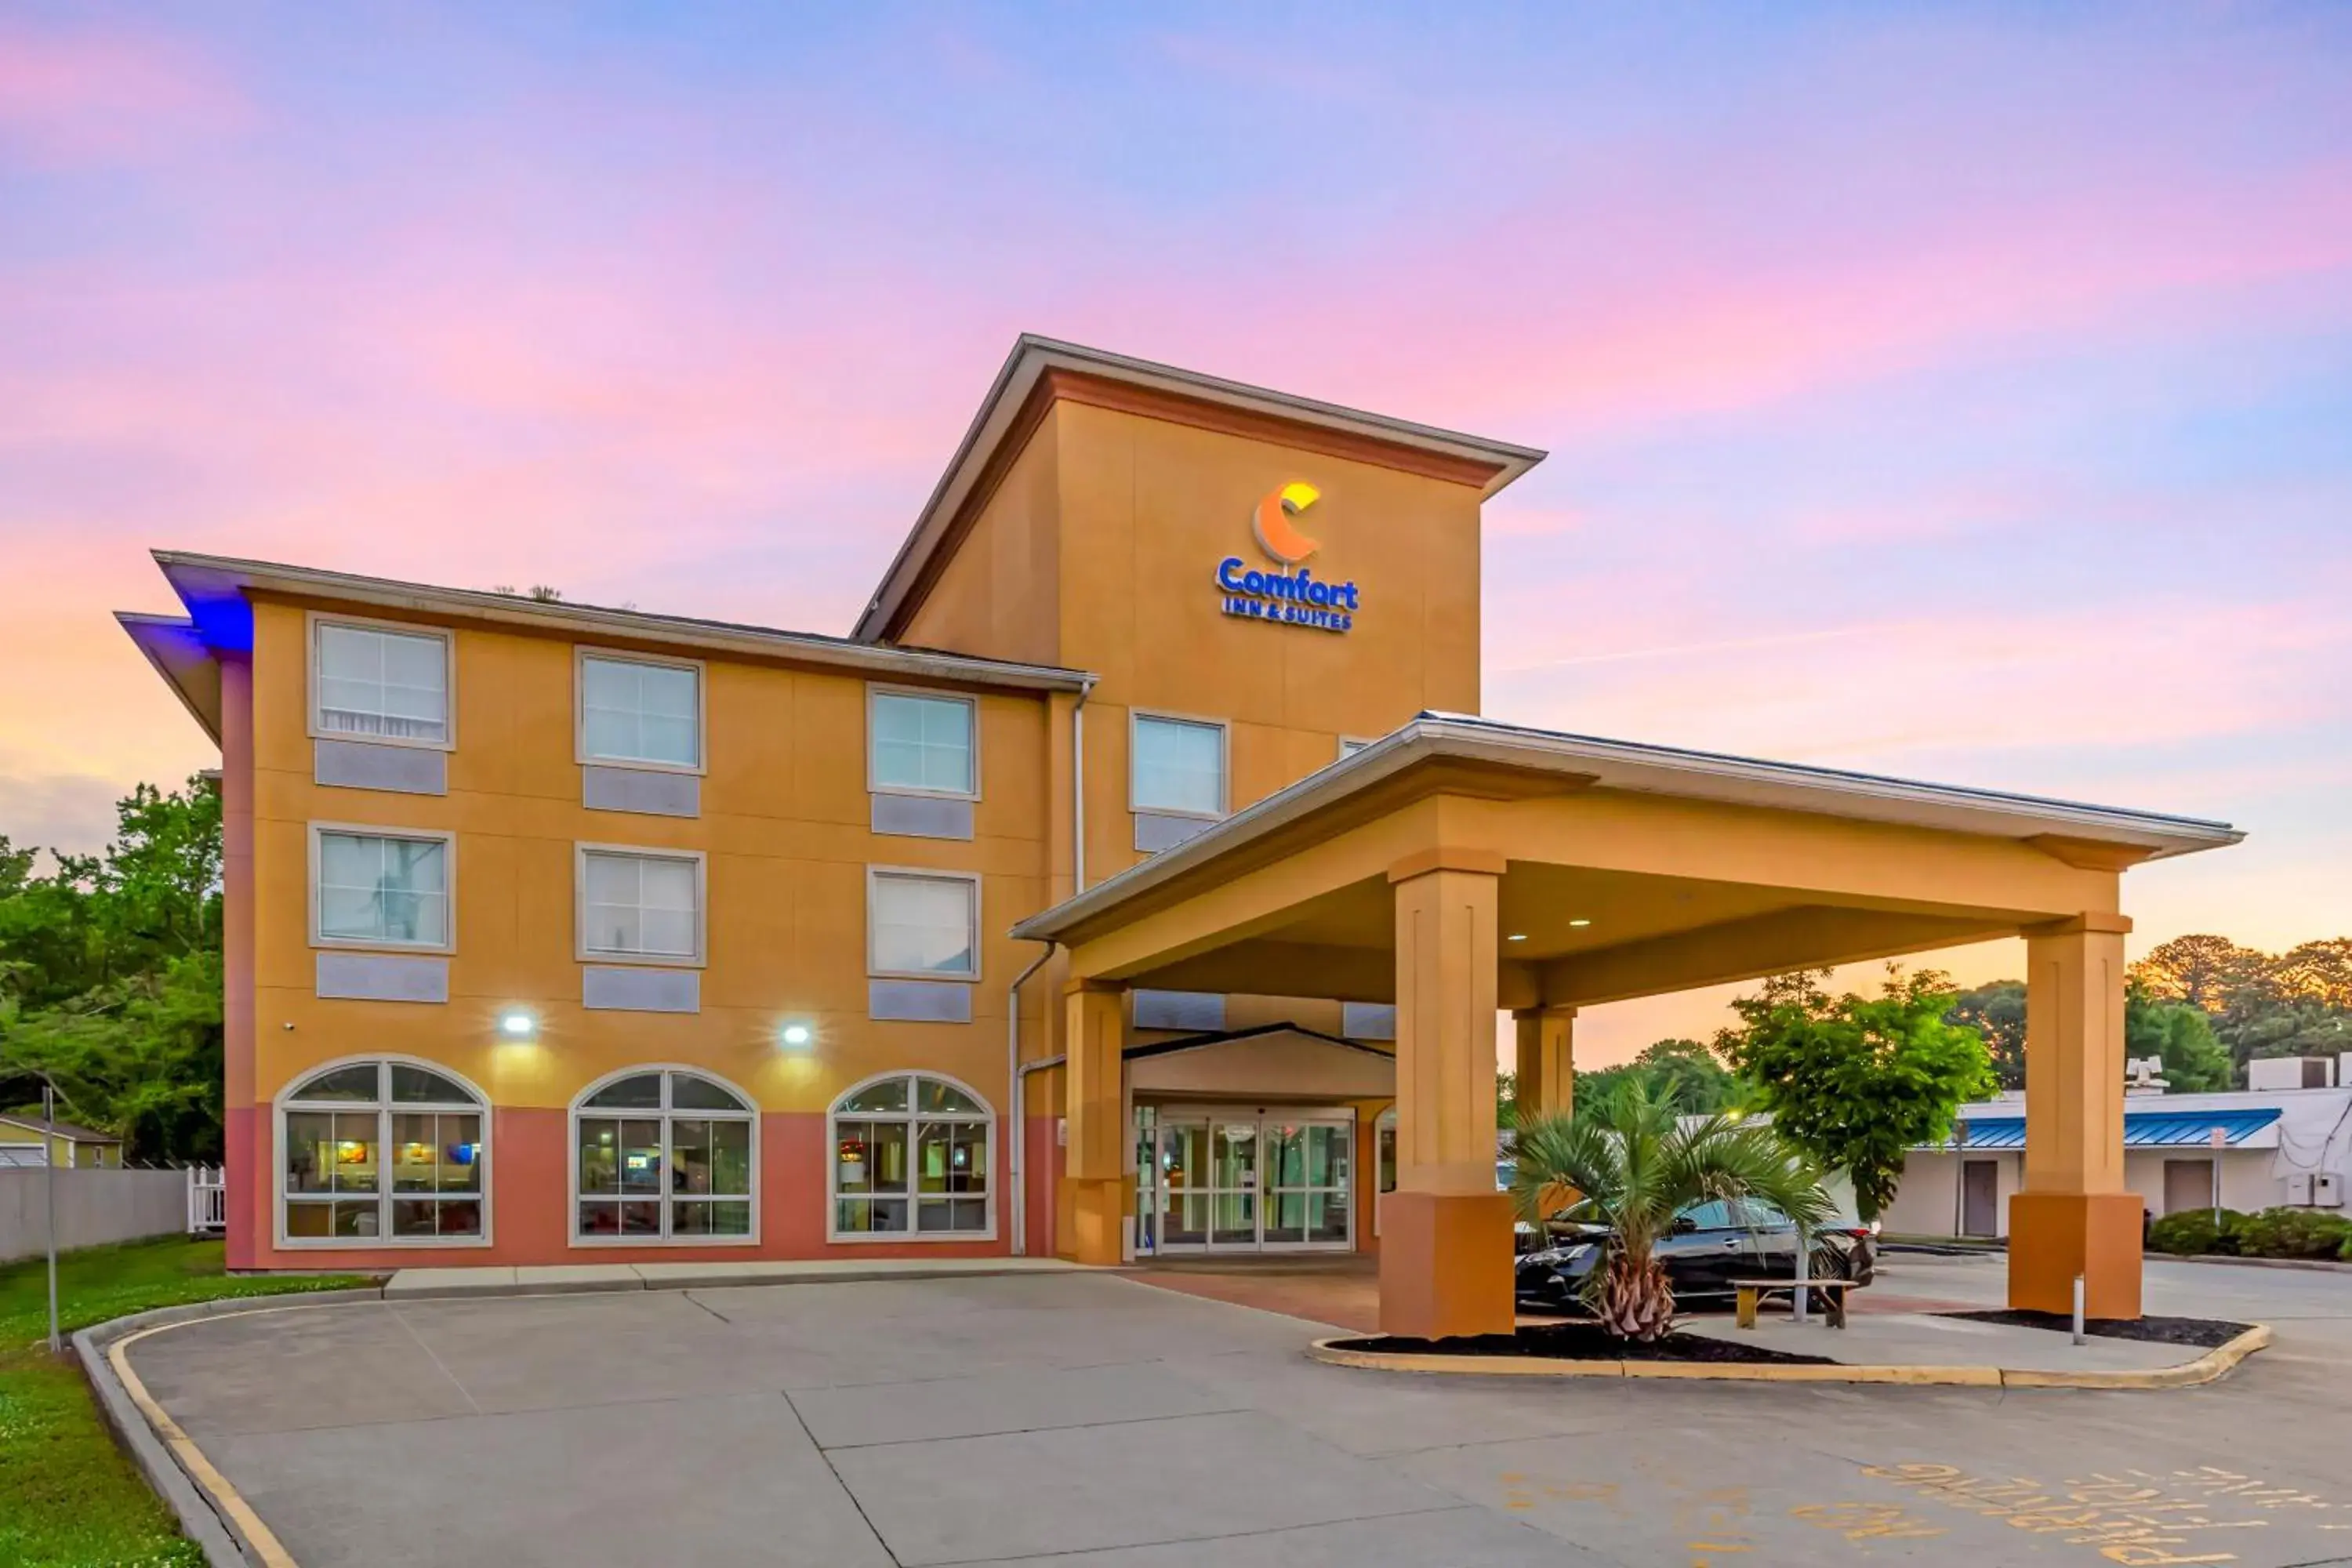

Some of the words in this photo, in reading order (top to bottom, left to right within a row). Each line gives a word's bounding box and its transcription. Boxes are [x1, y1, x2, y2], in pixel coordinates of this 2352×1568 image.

[1216, 557, 1359, 610] Comfort
[1223, 596, 1263, 617] INN
[1267, 603, 1281, 622] &
[1284, 605, 1352, 630] SUITES
